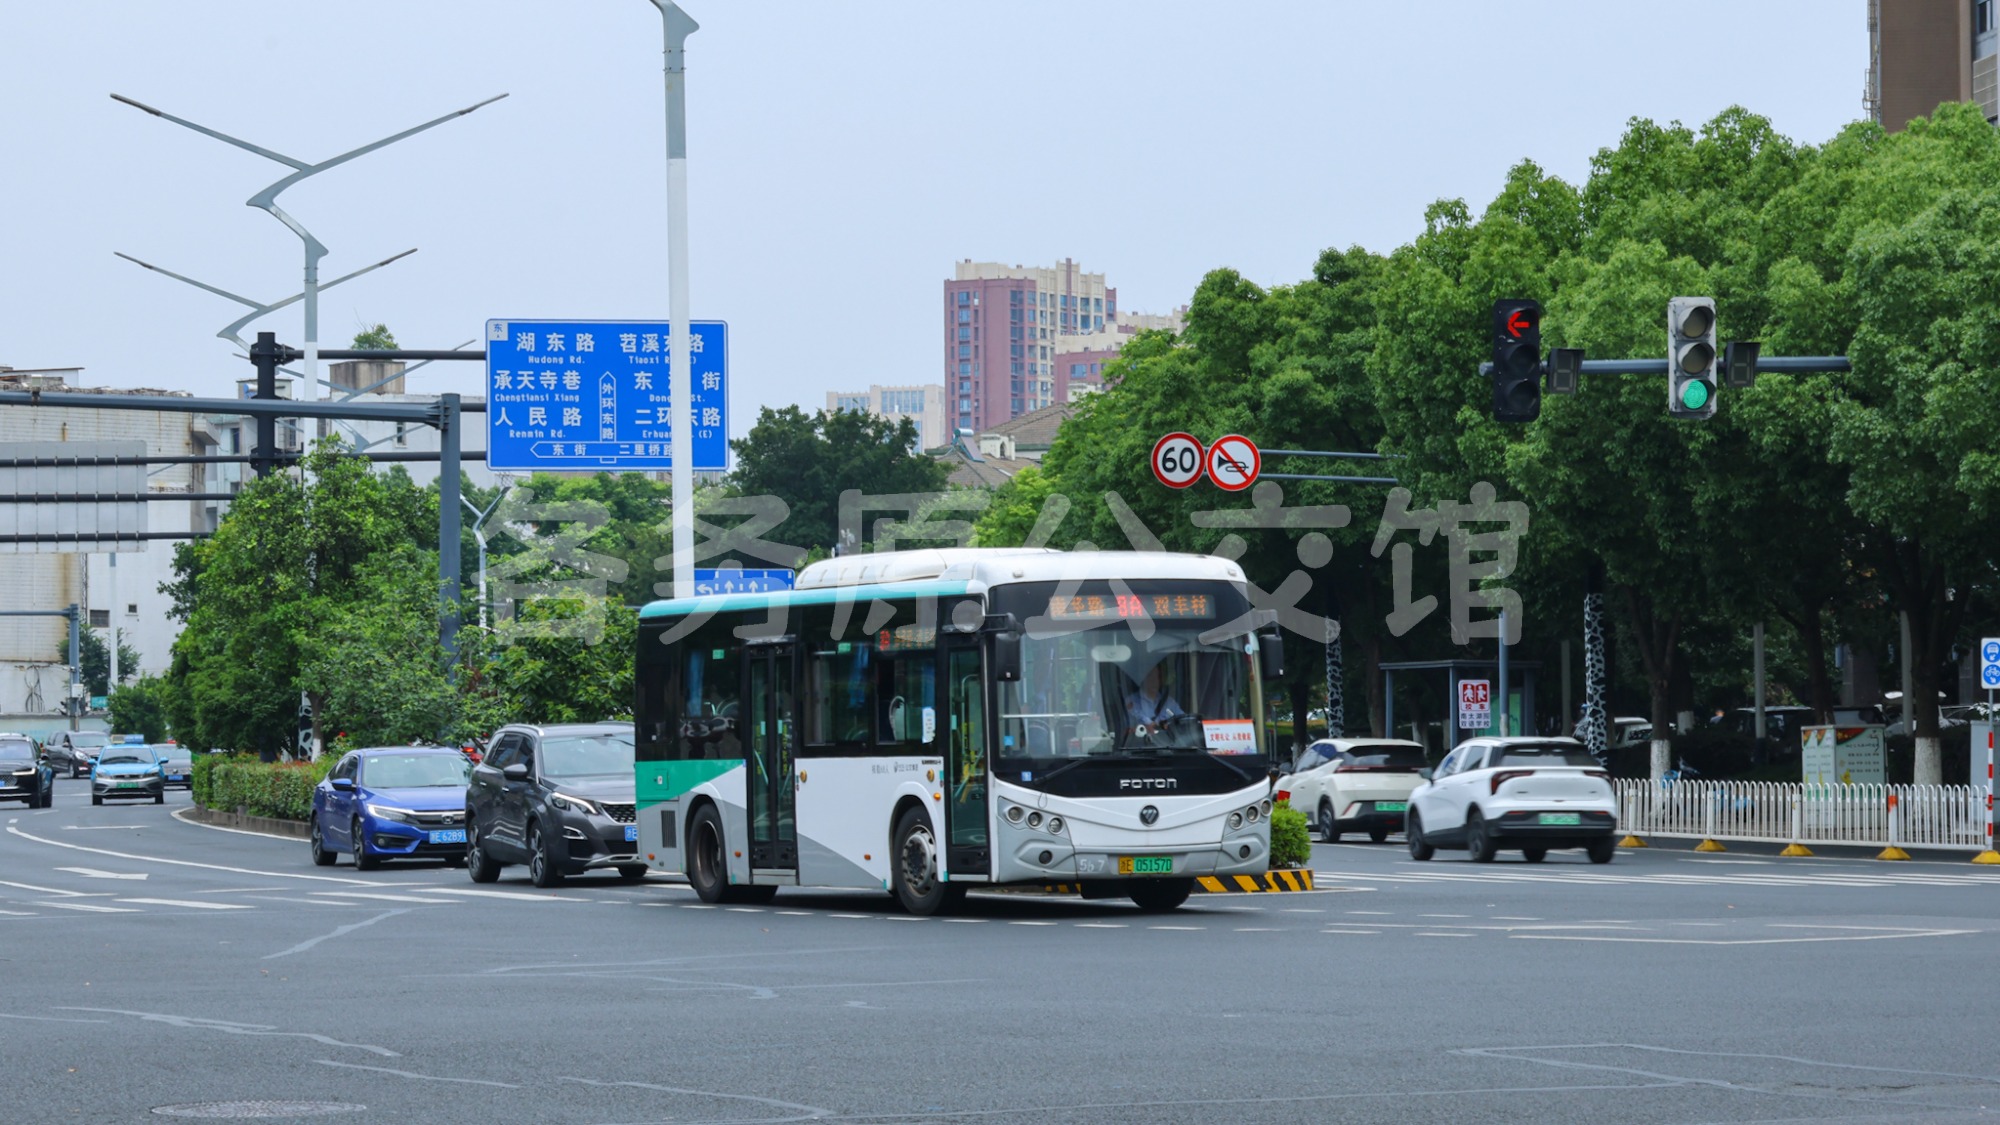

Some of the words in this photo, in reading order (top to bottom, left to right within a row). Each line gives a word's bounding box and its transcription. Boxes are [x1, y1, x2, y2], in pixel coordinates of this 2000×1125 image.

[494, 323, 503, 333] 东
[516, 332, 595, 352] 湖东路
[528, 355, 564, 365] Hudong
[569, 355, 585, 364] Rd.
[628, 355, 659, 364] Tiaoxi
[494, 370, 581, 390] 承天寺巷
[634, 371, 721, 391] 东街
[495, 393, 549, 403] Chengtiansi
[554, 393, 580, 403] Xiang
[495, 407, 582, 427] 人民路
[602, 383, 614, 439] 外环东路
[509, 429, 544, 439] Renmin
[550, 429, 566, 438] Rd.
[642, 430, 672, 438] Erhua
[698, 430, 713, 439] (E)
[552, 444, 587, 456] 东街
[1162, 446, 1196, 473] 60
[1117, 595, 1143, 617] 8A
[1120, 778, 1178, 789] FOTON
